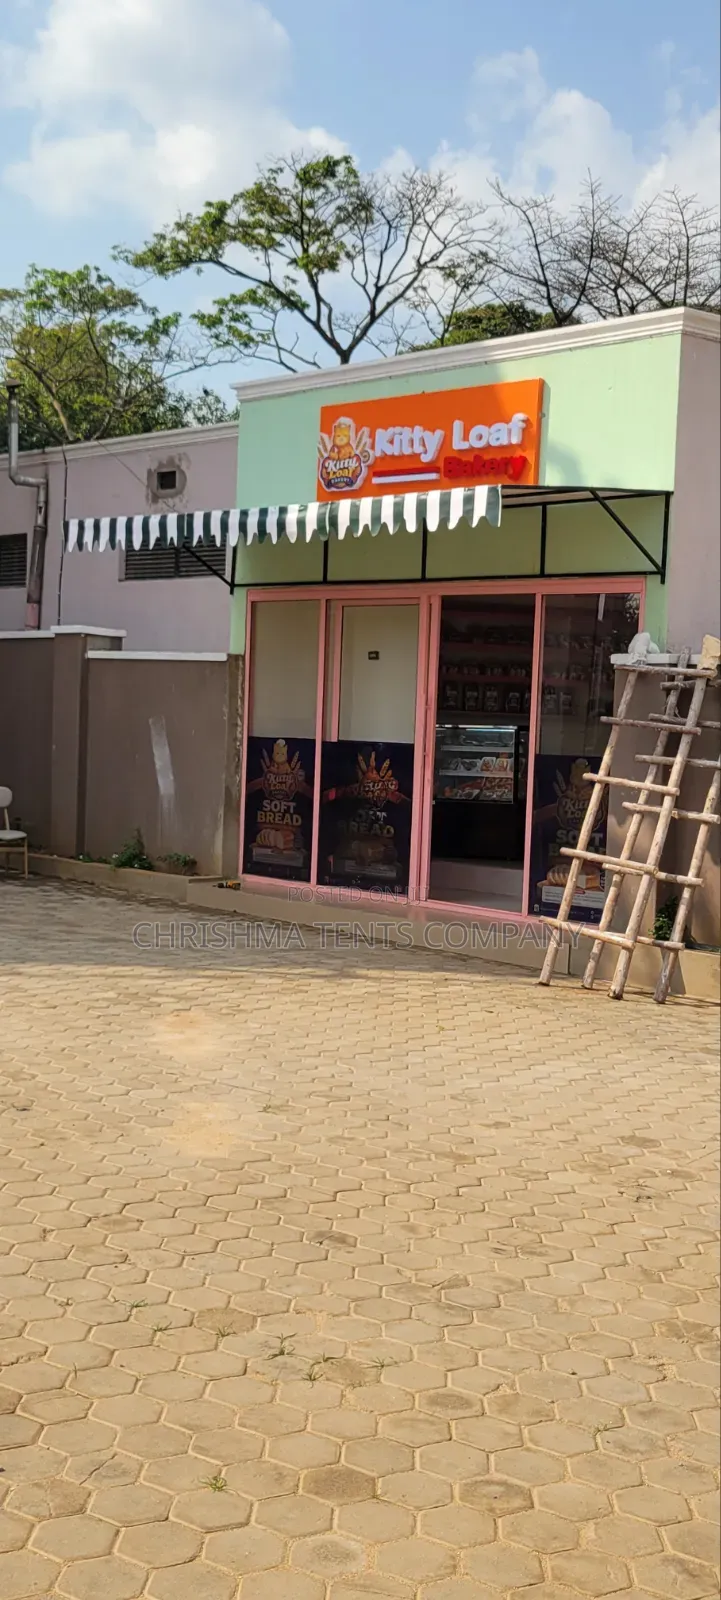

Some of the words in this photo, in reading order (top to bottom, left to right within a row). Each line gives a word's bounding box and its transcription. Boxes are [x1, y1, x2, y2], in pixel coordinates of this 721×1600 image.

[374, 425, 445, 463] Kitty
[451, 412, 529, 450] Loaf
[325, 458, 359, 472] Kitty
[329, 467, 355, 479] Loaf
[443, 454, 527, 482] Bakery
[262, 799, 297, 814] SOFT
[256, 810, 302, 826] BREAD
[556, 829, 604, 847] SOT
